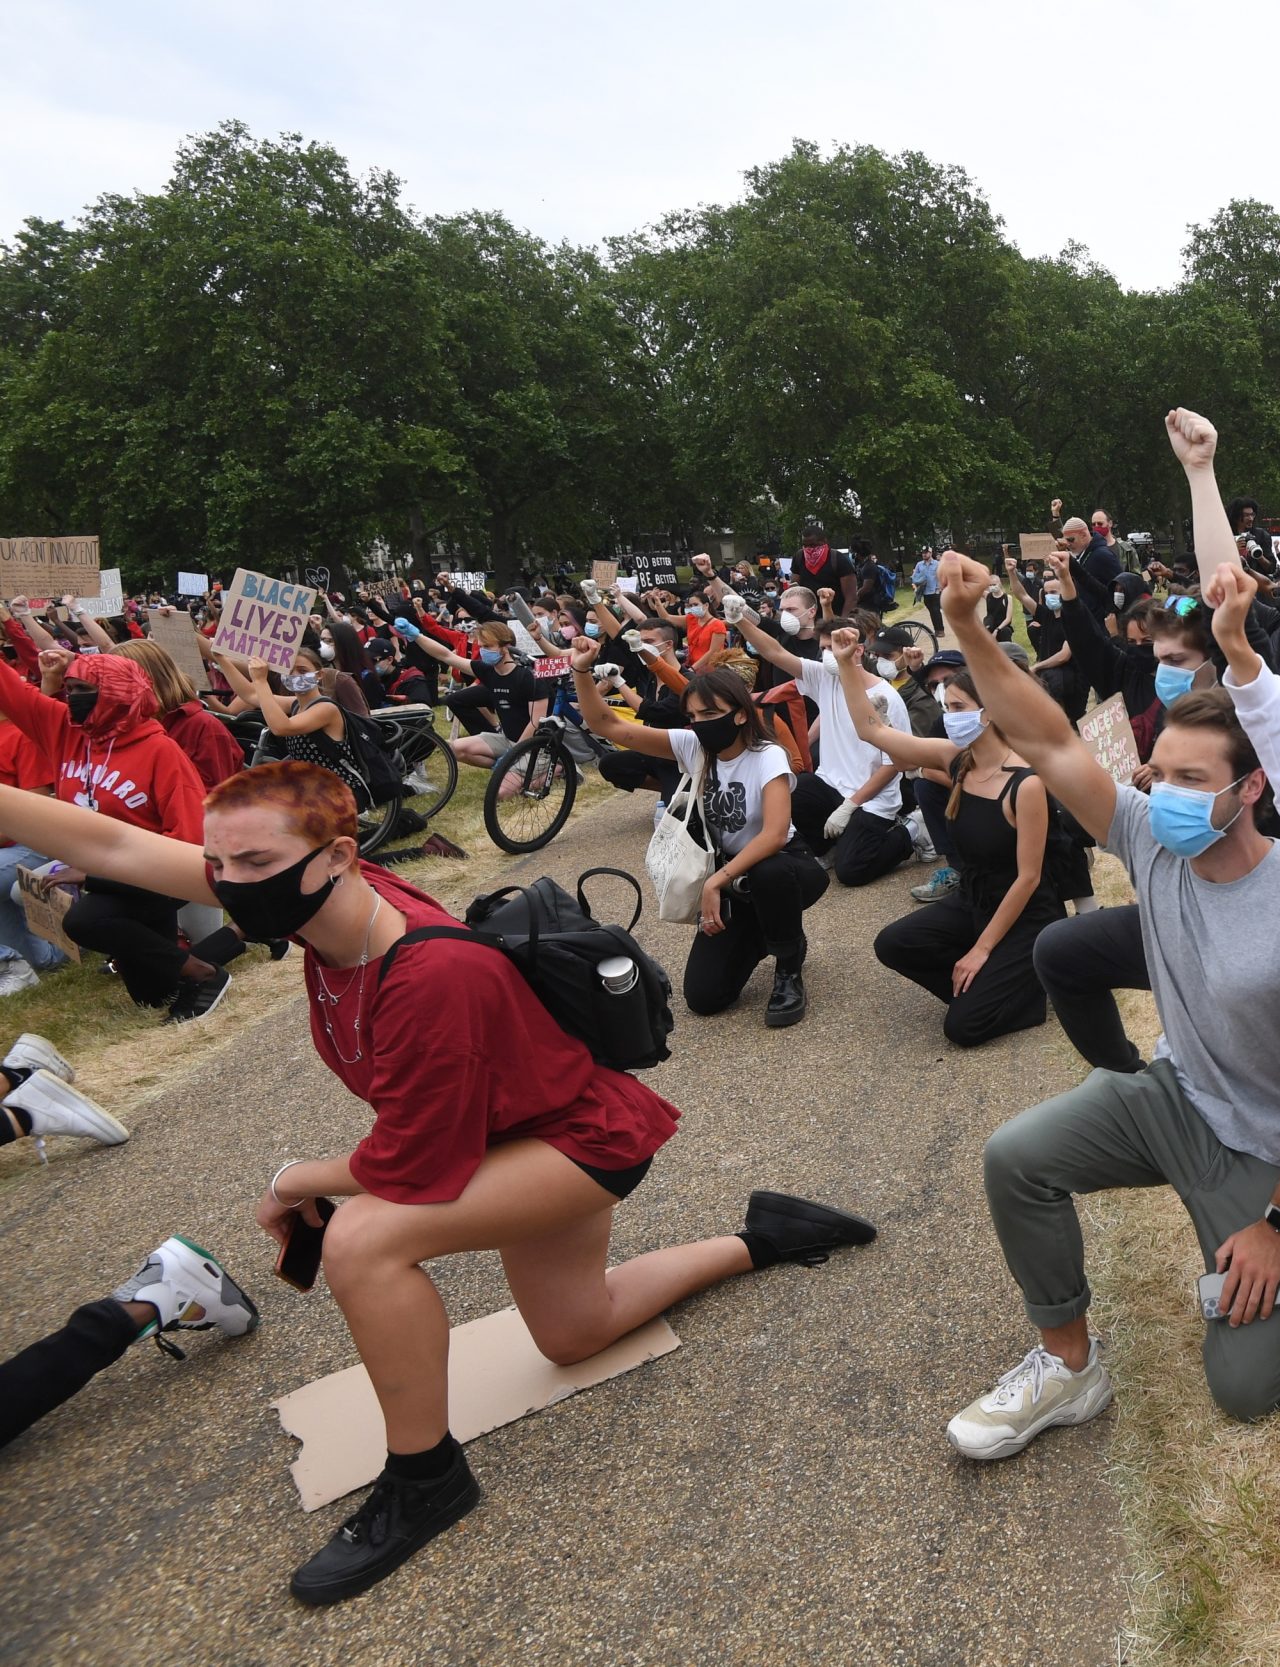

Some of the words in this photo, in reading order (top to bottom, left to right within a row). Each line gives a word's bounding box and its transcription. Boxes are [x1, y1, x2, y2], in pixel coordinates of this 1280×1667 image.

[49, 540, 99, 565] INNOCENT
[635, 556, 649, 568] DO
[651, 557, 672, 567] BETTER
[310, 573, 328, 584] BLM
[461, 572, 468, 580] IN
[471, 572, 484, 580] THIS
[639, 571, 653, 588] BE
[655, 574, 677, 585] BETTER
[450, 580, 485, 591] OGETHER
[241, 573, 310, 615] BLACK
[230, 599, 303, 643] LIVES
[215, 626, 295, 669] MATTER
[535, 657, 568, 666] SILENCE
